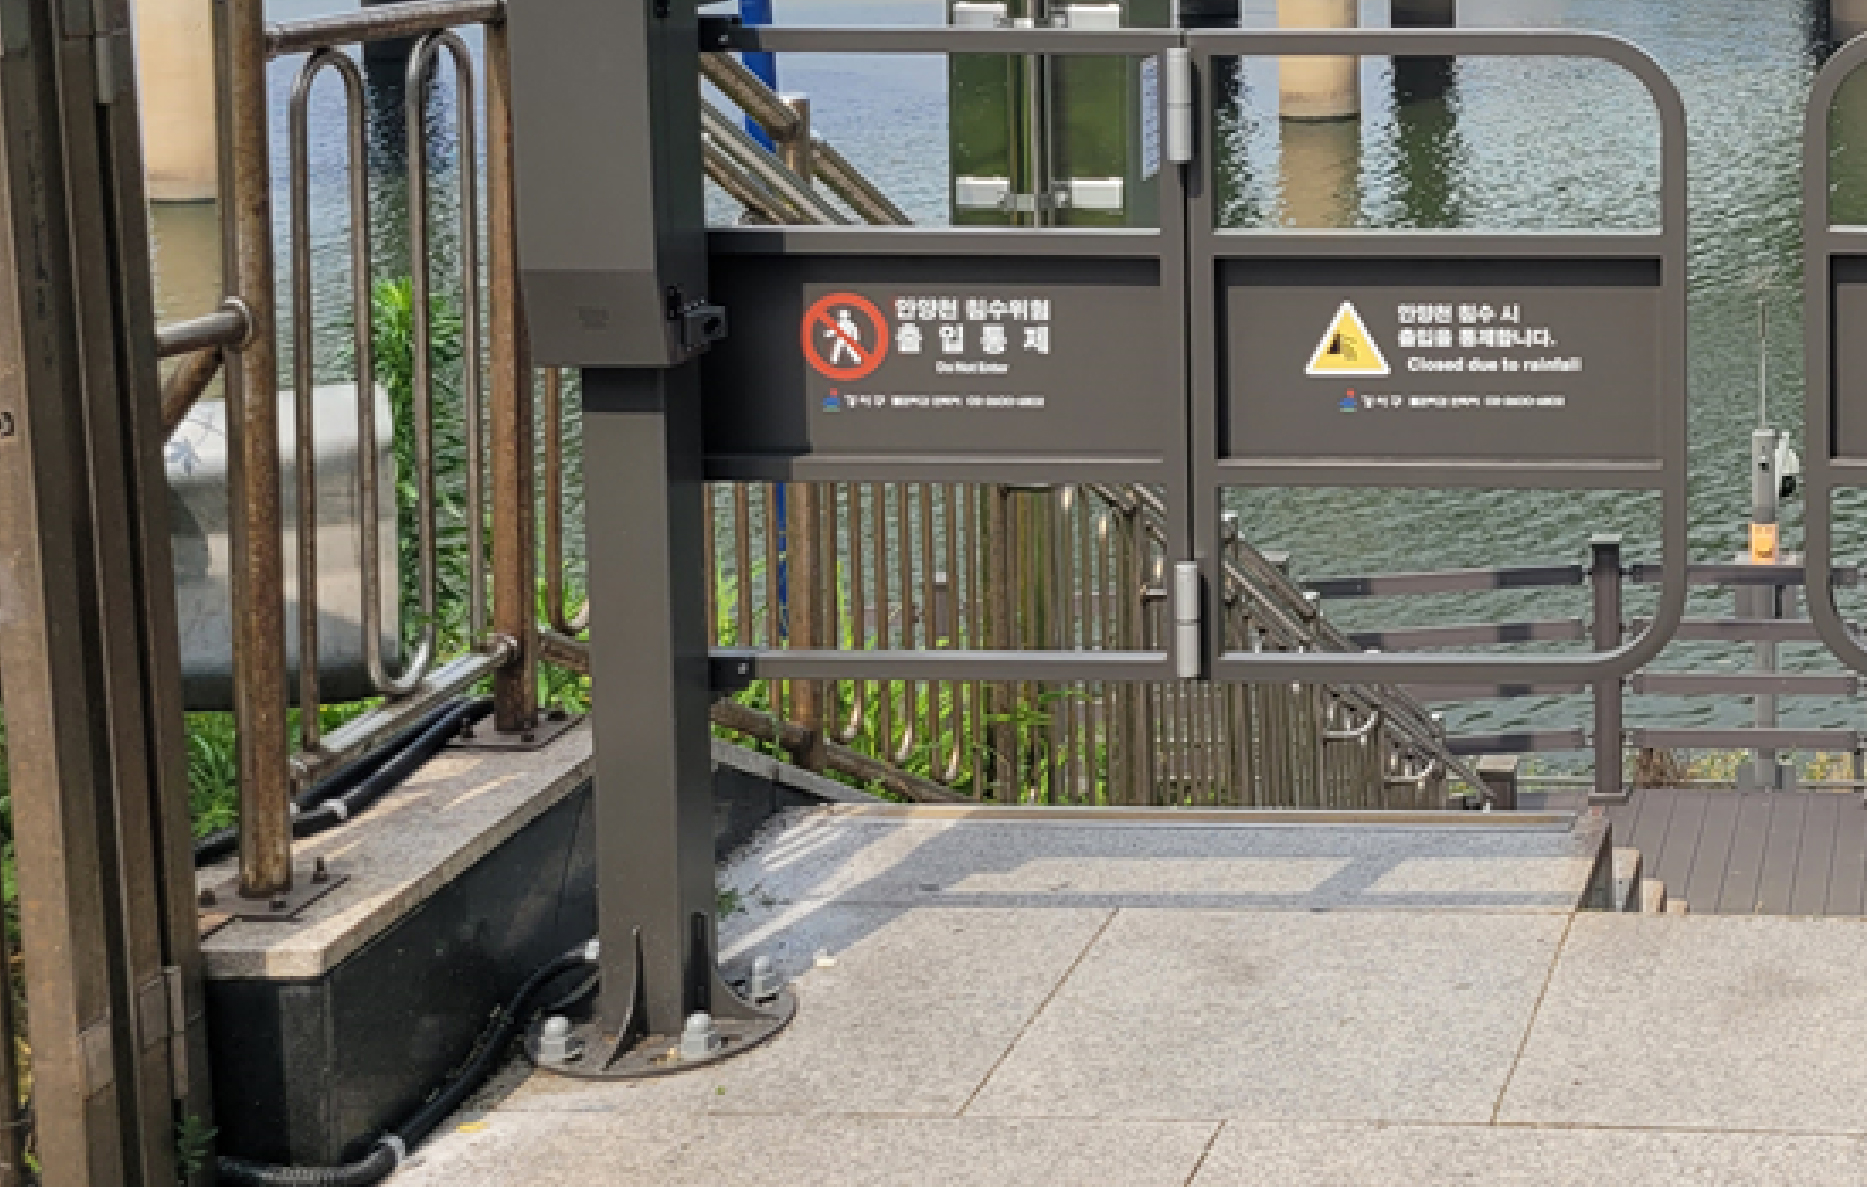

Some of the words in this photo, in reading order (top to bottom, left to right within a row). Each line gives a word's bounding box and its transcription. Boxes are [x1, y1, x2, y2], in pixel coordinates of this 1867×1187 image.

[893, 297, 960, 322] 안양천
[965, 297, 1052, 322] 침수위험
[1397, 304, 1453, 325] 안양천
[1458, 304, 1496, 325] 침수
[1499, 304, 1521, 325] 시
[978, 361, 1009, 376] Enter
[1406, 357, 1464, 373] Closed
[1467, 357, 1498, 373] due
[1501, 357, 1520, 373] to
[1522, 357, 1583, 373] rainfall
